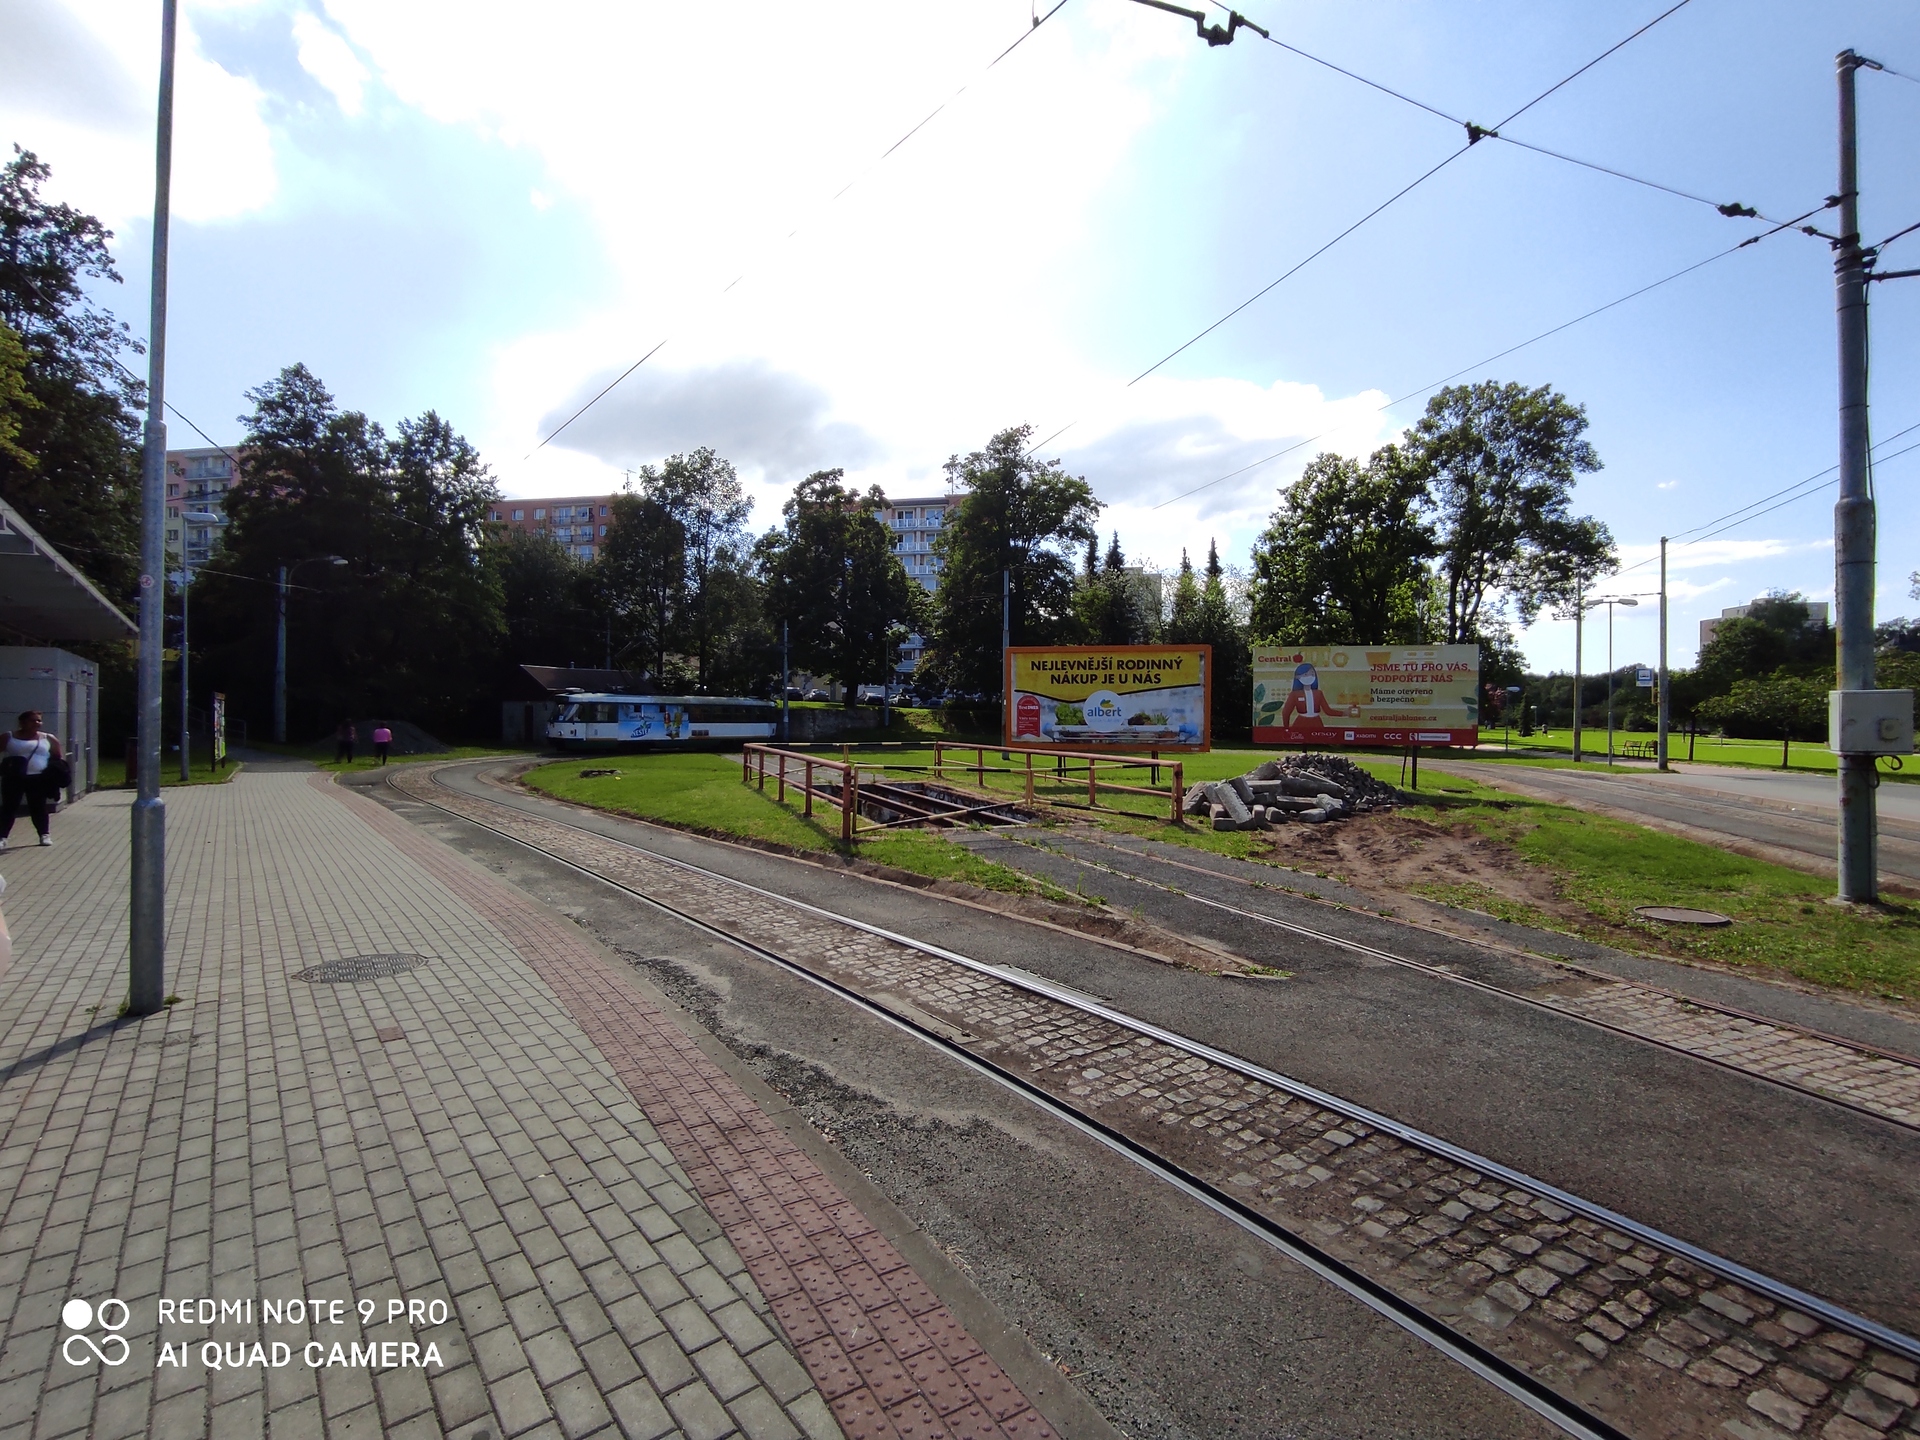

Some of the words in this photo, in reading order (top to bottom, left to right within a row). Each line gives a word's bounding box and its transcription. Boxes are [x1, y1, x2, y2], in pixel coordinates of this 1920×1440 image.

[1030, 656, 1113, 671] NEJLEVNĚJŠÍ
[1116, 655, 1183, 671] RODINNÝ
[1258, 655, 1292, 663] Central
[1370, 663, 1400, 671] JSME
[1403, 663, 1418, 671] TU
[1421, 663, 1443, 671] PRO
[1446, 661, 1471, 672] VÁS,
[1051, 671, 1098, 685] NÁKUP
[1101, 673, 1114, 685] JE
[1118, 673, 1128, 684] U
[1132, 671, 1161, 684] NÁS
[1370, 673, 1428, 682] PODPOŘTE
[1430, 673, 1453, 682] NÁS
[1370, 687, 1396, 695] Máme
[1397, 687, 1433, 695] otevřeno
[1376, 695, 1415, 704] bezpečno
[1087, 706, 1122, 717] albert
